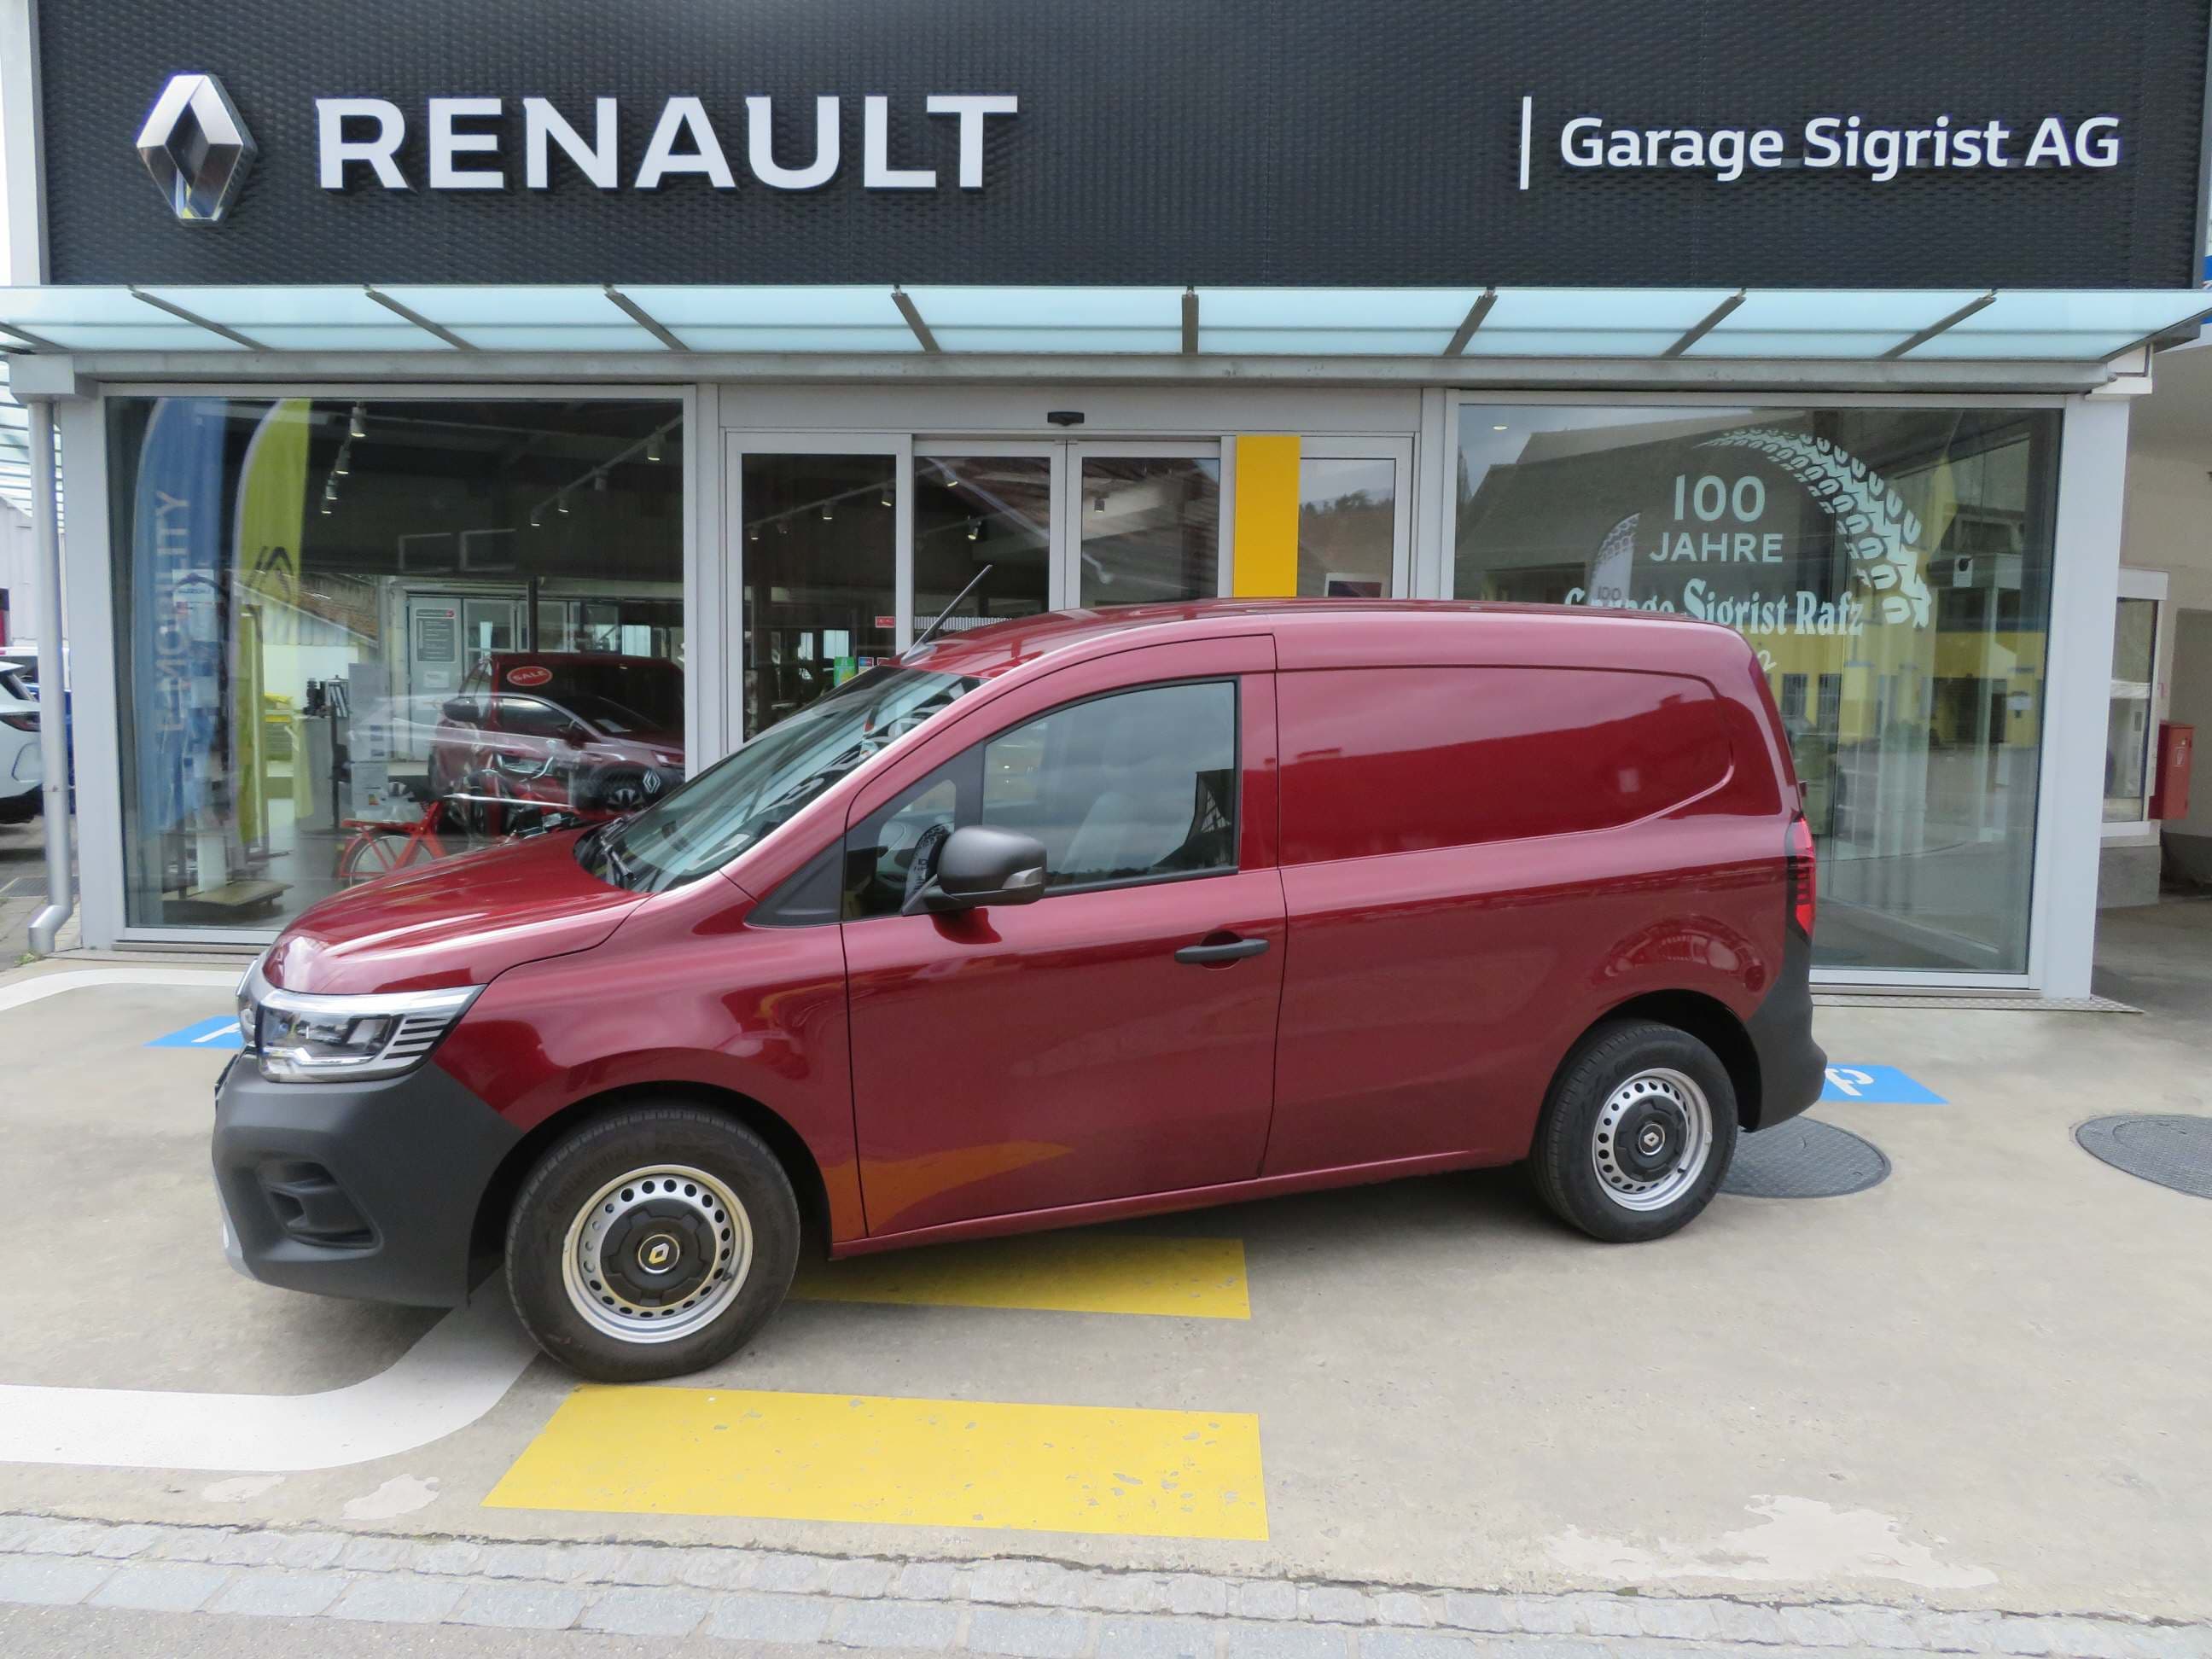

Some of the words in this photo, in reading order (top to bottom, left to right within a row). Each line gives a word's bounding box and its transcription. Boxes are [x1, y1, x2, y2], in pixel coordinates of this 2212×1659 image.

[316, 96, 1018, 189] RENAULT
[1561, 117, 1784, 182] Garage
[1804, 115, 2010, 182] Sigrist
[2024, 116, 2120, 167] AG
[1674, 474, 1766, 522] 100
[1649, 532, 1784, 563] JAHRE
[1683, 578, 1788, 635] Sigrist
[1794, 591, 1865, 636] Rafz
[512, 670, 547, 682] SALE
